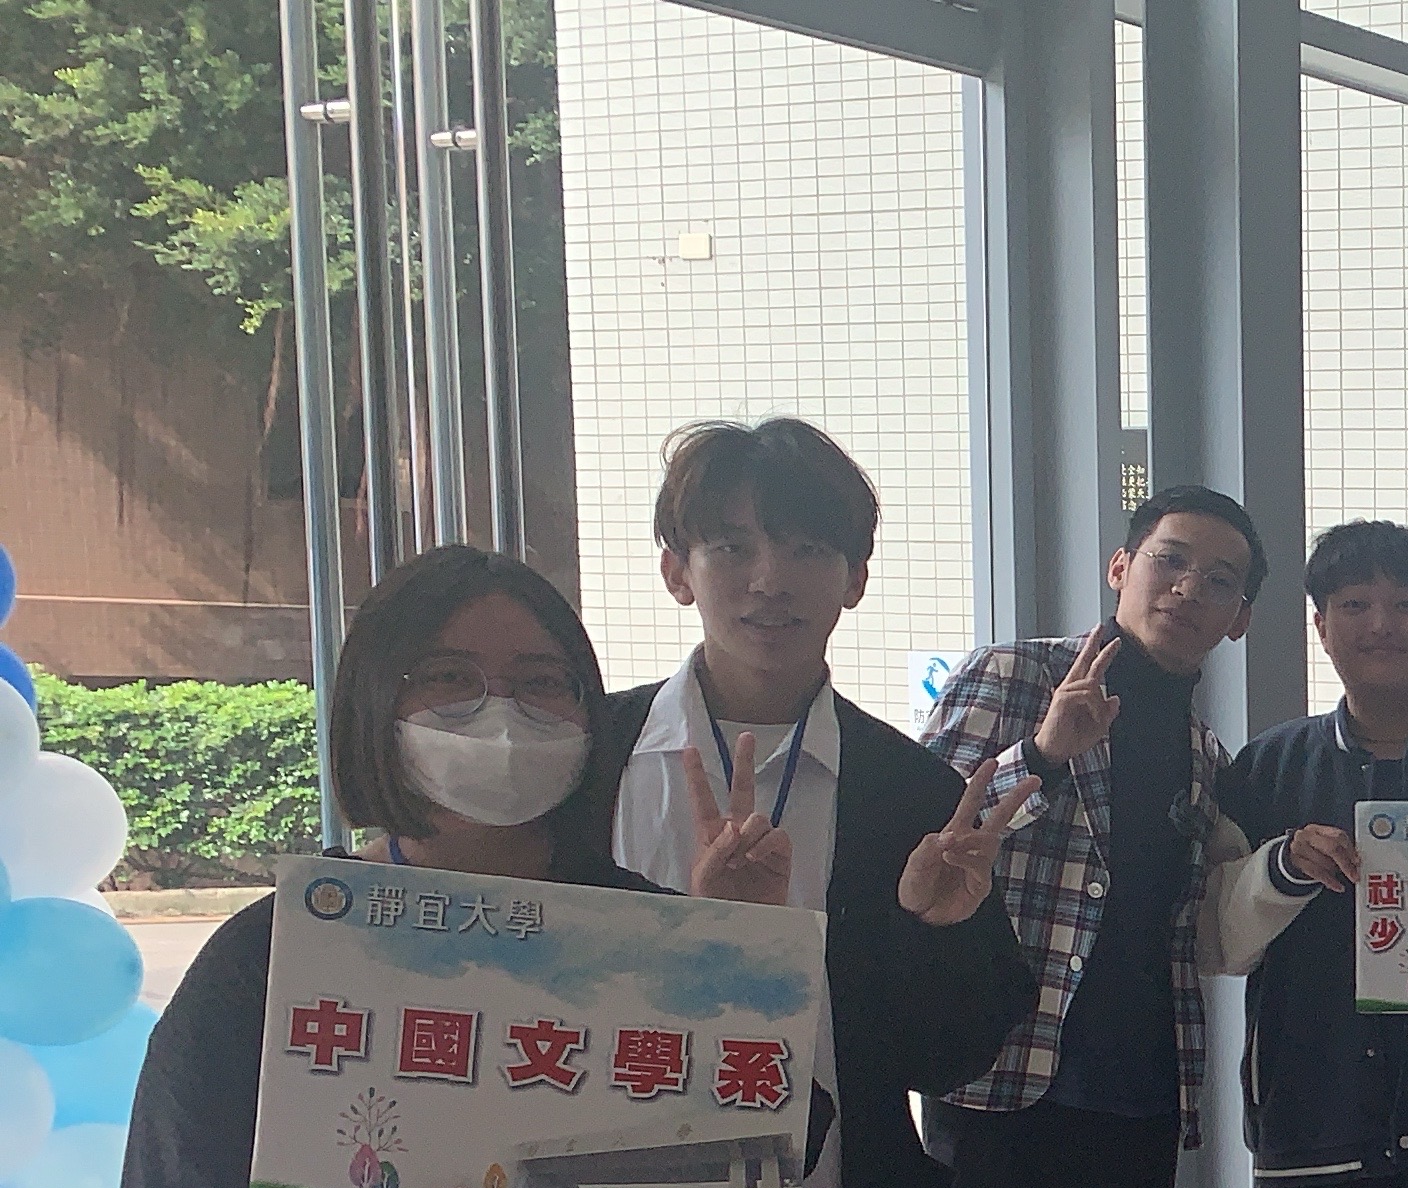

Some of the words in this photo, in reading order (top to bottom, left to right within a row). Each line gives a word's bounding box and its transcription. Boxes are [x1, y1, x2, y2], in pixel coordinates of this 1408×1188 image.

[364, 882, 545, 940] 靜宜大學
[287, 998, 792, 1110] 中國文學系
